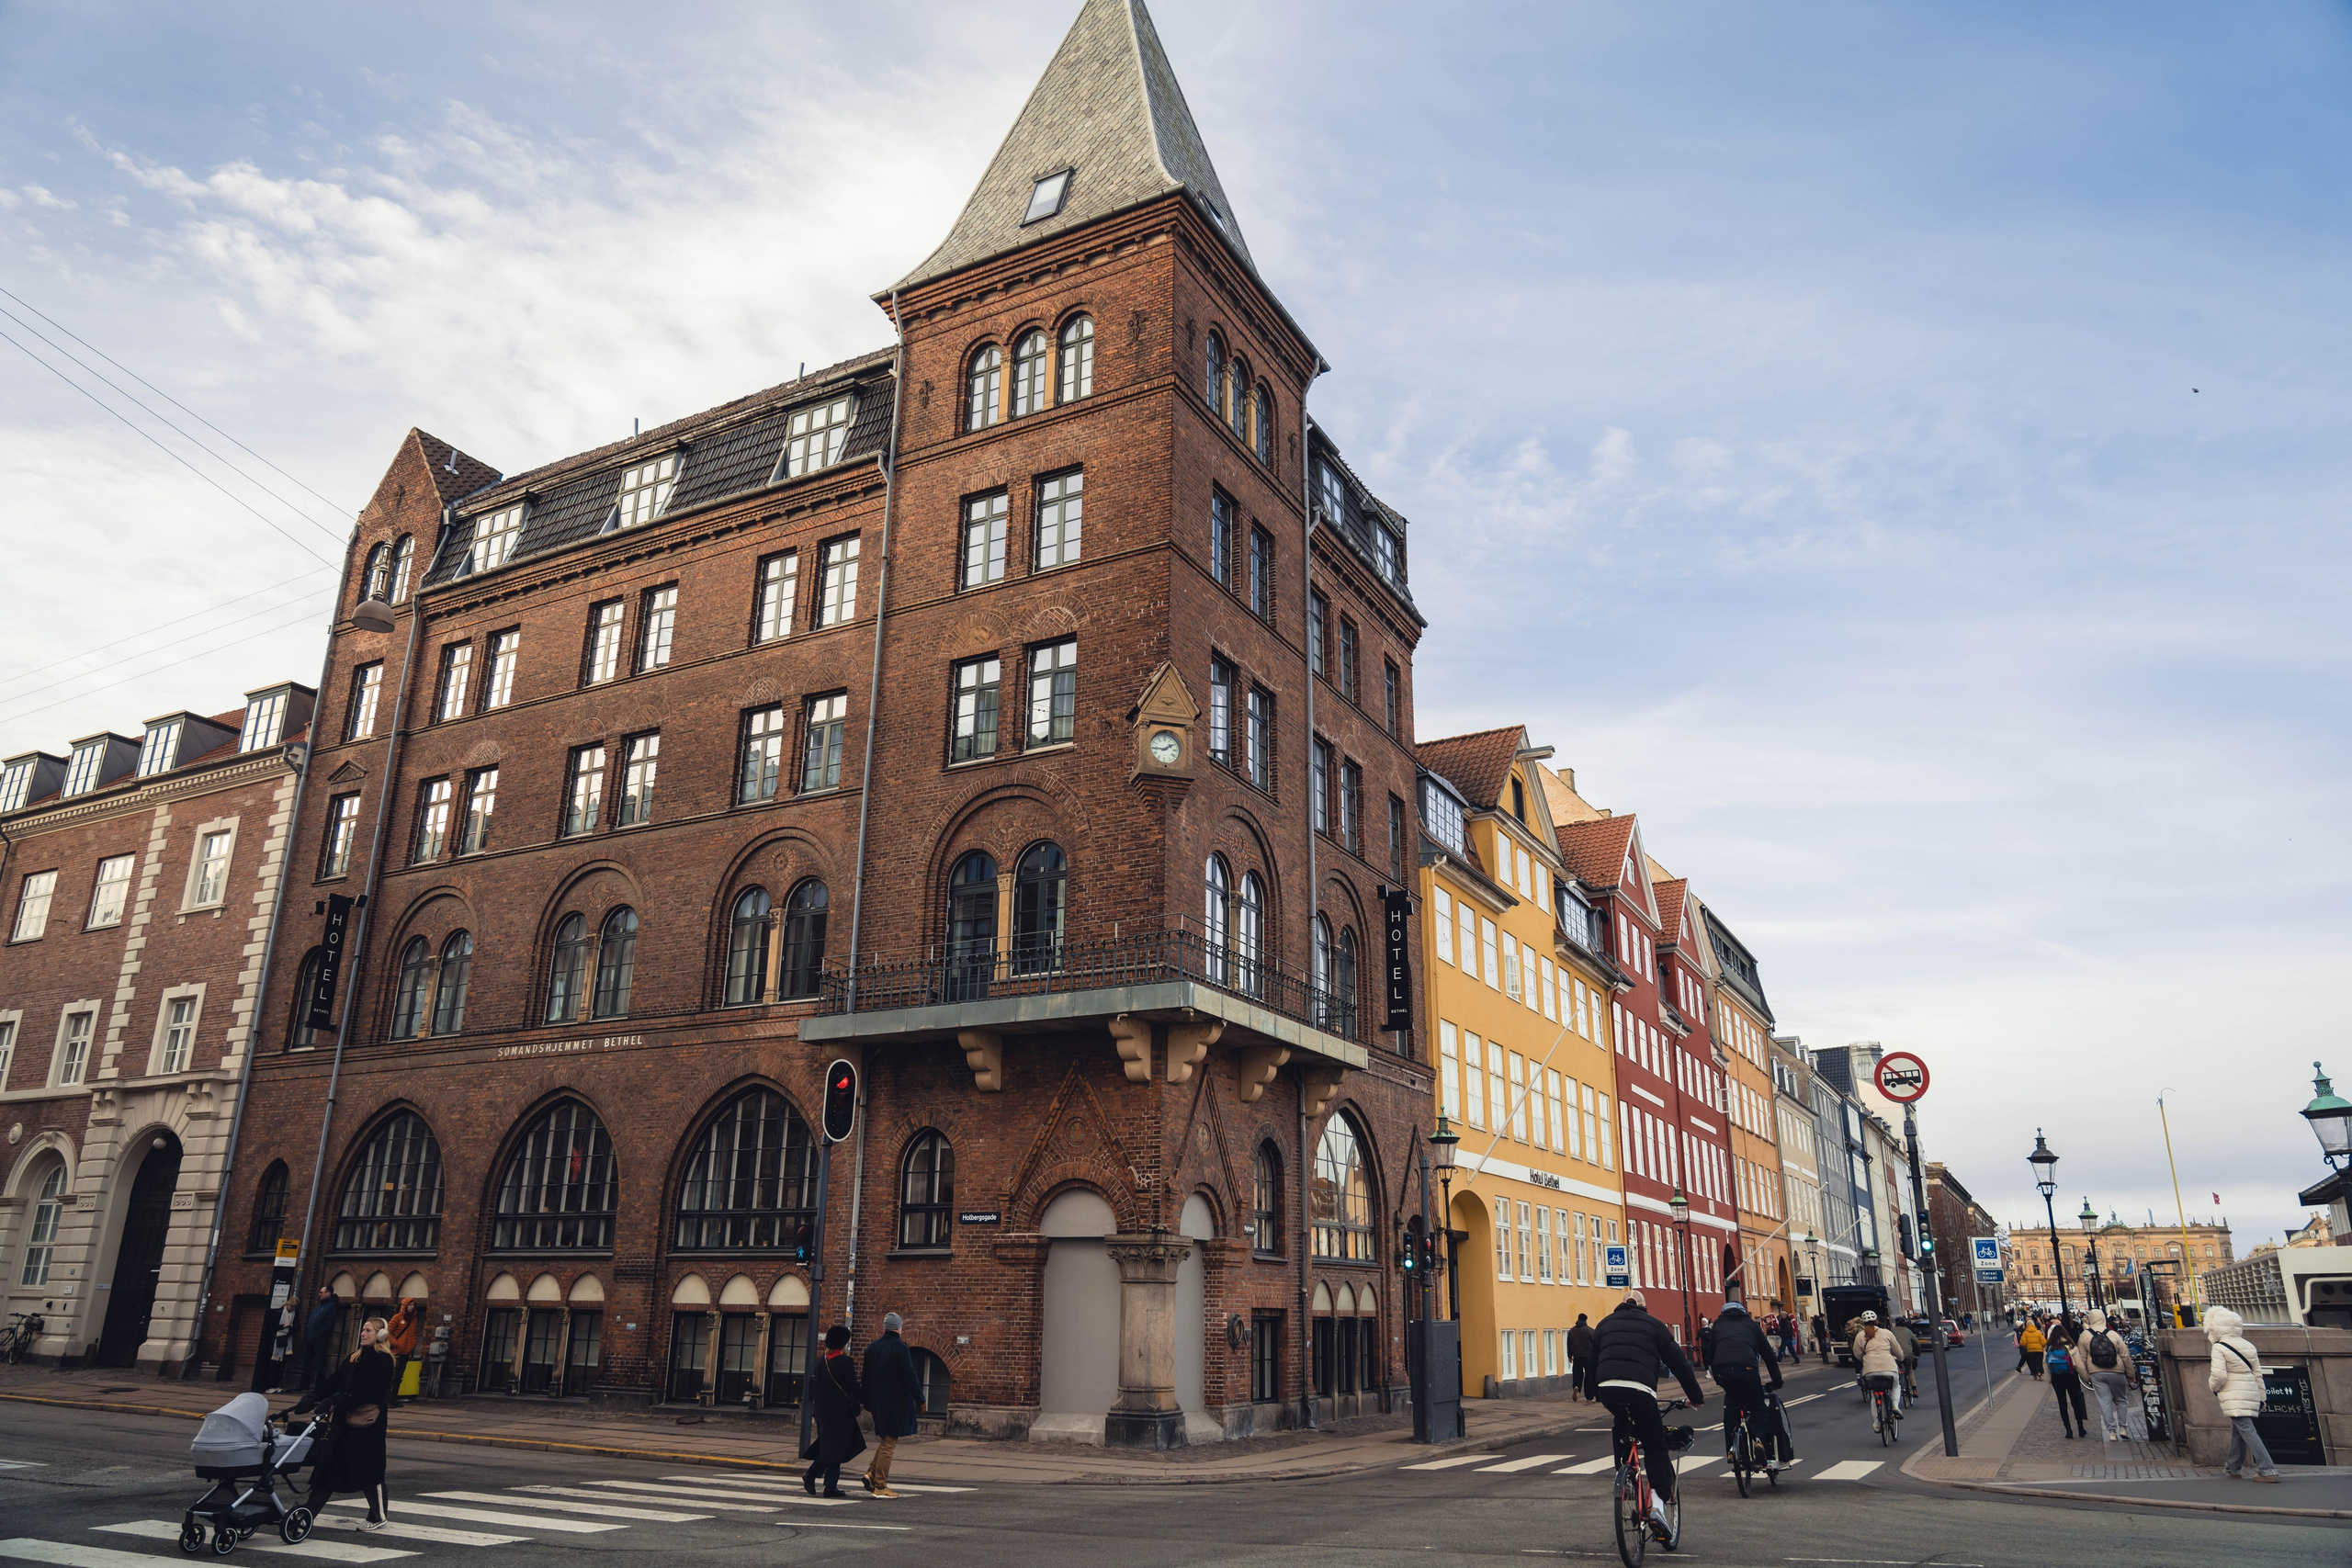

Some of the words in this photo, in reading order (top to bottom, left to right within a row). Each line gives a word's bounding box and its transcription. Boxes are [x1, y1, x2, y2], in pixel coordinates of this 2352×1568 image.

[320, 913, 343, 1000] HOTEL
[1391, 909, 1403, 999] HOTEL
[497, 1039, 594, 1057] SØMANDSHJEMMET
[604, 1034, 643, 1048] BETHEL
[1530, 1168, 1544, 1185] Hotel
[1544, 1173, 1559, 1190] Bethel
[962, 1213, 997, 1222] Holbergsgade
[2266, 1387, 2284, 1395] oilet
